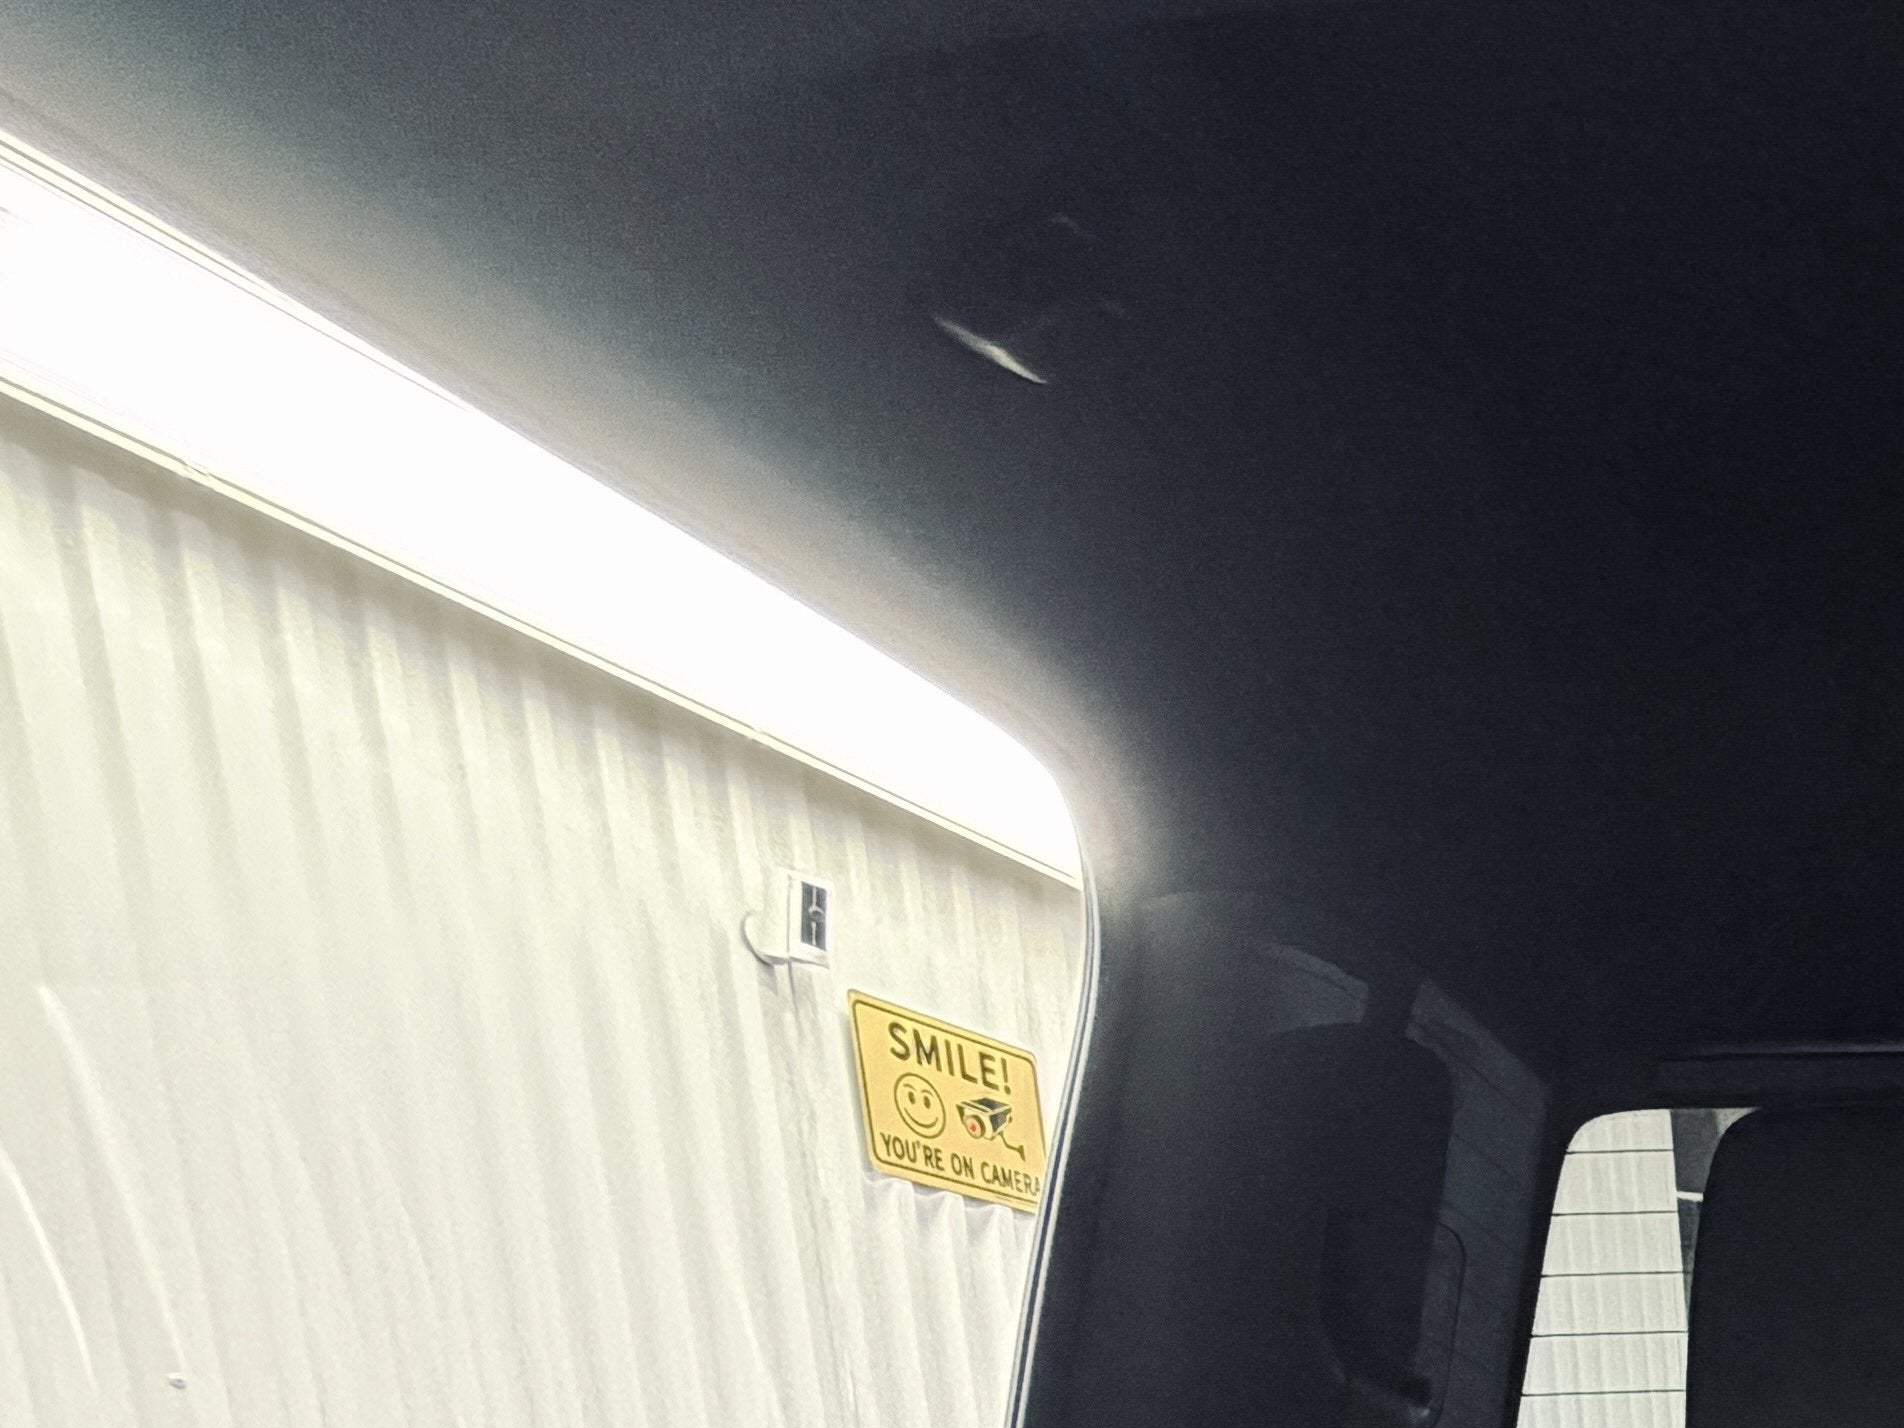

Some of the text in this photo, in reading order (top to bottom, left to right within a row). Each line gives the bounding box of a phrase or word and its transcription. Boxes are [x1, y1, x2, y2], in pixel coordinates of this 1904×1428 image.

[888, 1021, 1011, 1095] SMILE!
[880, 1132, 945, 1172] YOU'RE
[950, 1152, 975, 1180] ON
